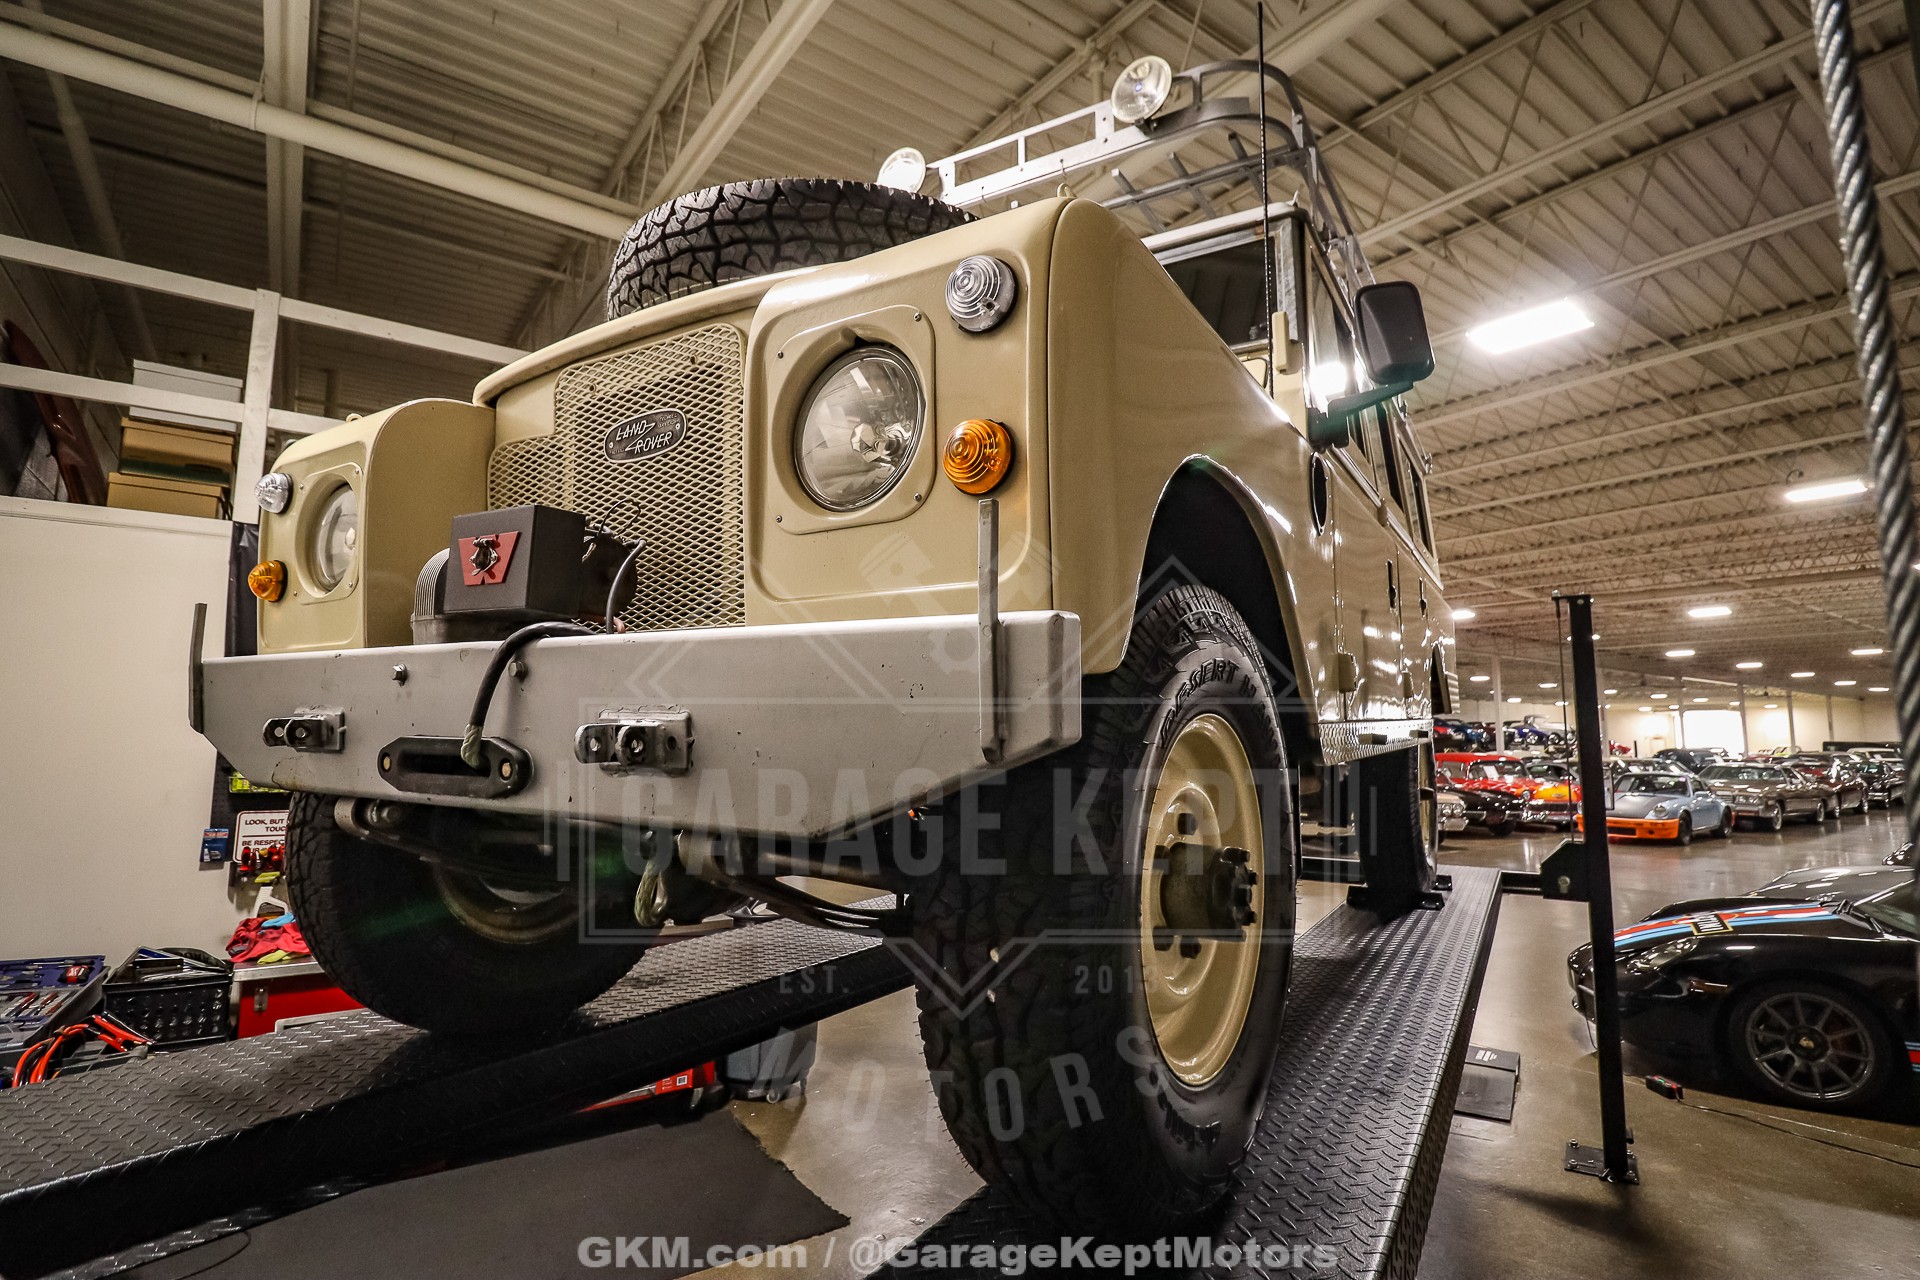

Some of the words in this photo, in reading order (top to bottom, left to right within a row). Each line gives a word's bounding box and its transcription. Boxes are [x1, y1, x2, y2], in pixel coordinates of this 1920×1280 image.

[615, 419, 648, 441] LAND
[633, 431, 673, 454] ROVER
[1160, 657, 1240, 749] DESERT
[244, 818, 268, 826] LOOK,
[254, 838, 285, 846] RESPEC
